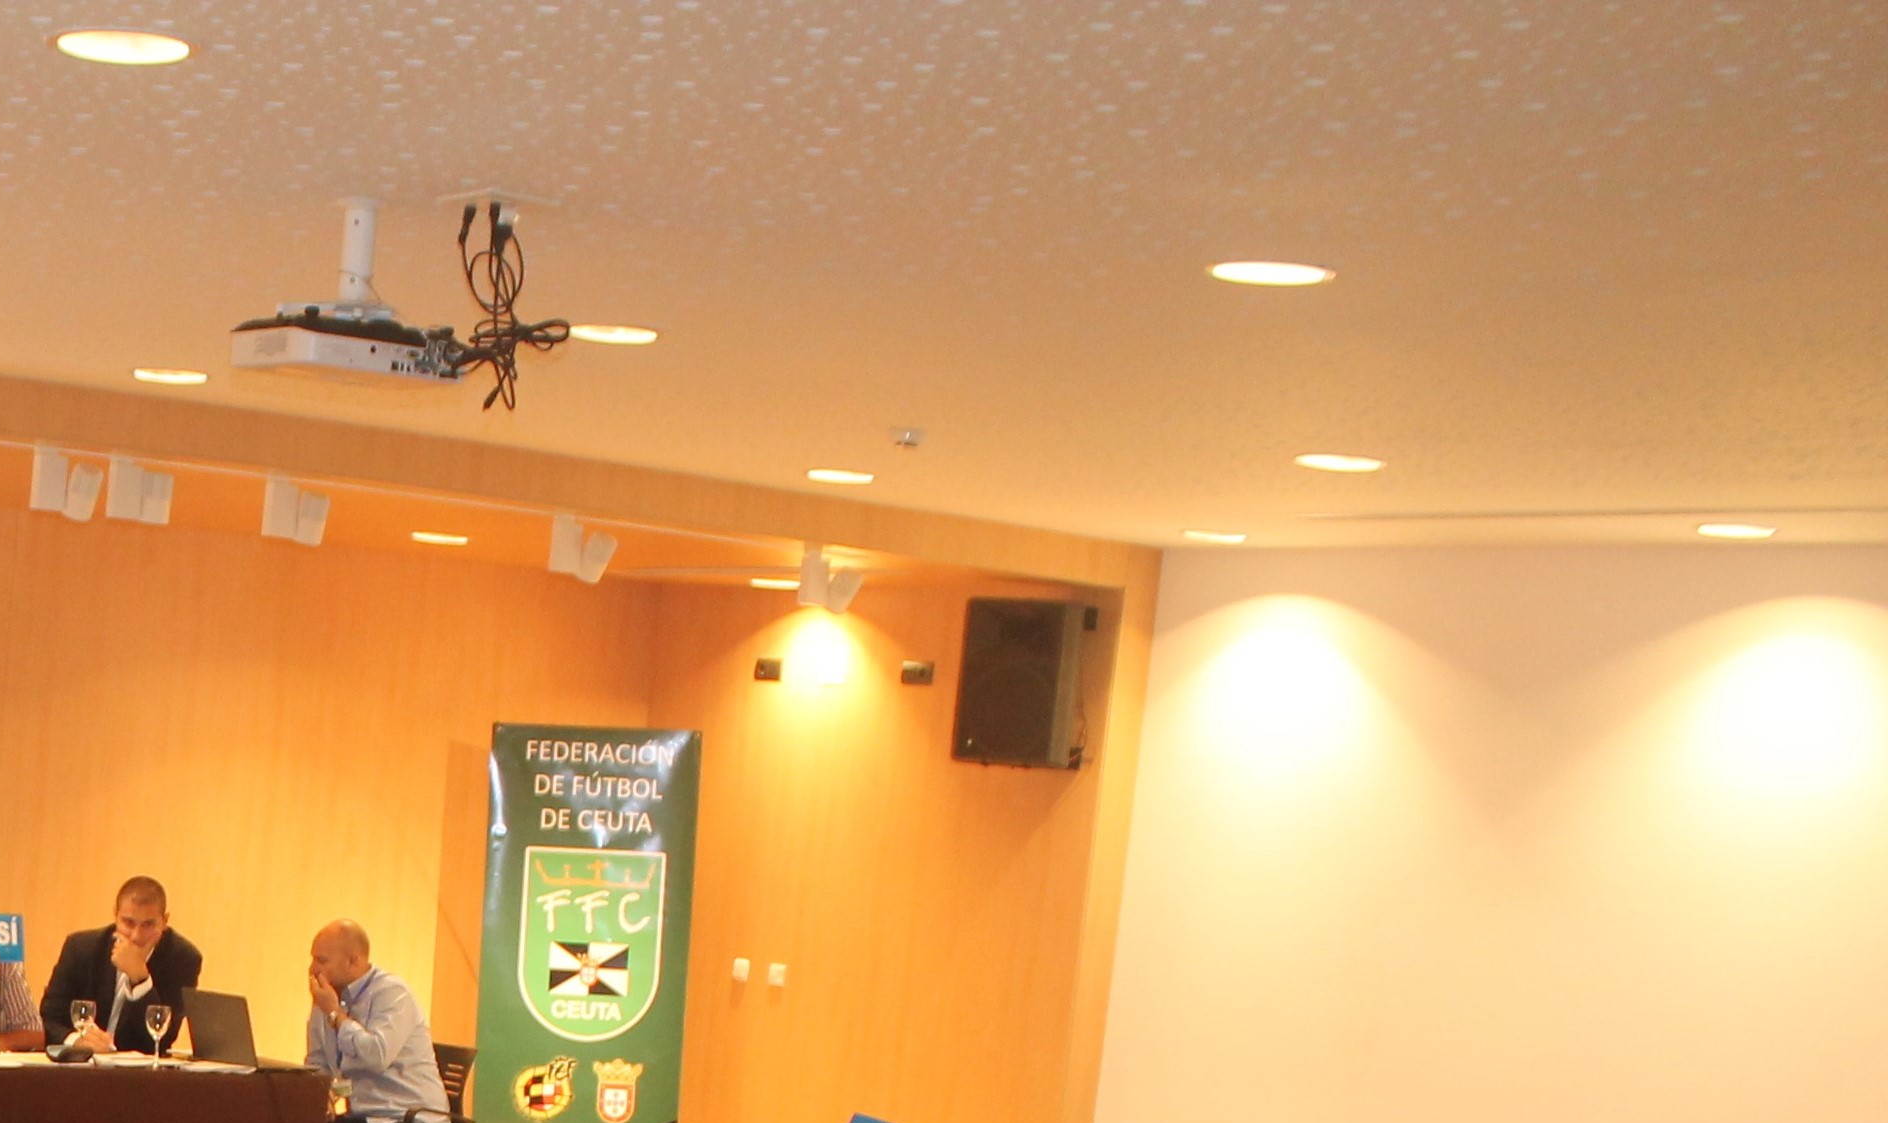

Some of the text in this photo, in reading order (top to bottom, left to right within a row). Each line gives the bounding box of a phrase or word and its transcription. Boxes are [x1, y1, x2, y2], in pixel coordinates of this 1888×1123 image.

[526, 739, 674, 767] FEDERACIÓN
[534, 771, 663, 800] DE FÚTBOL
[540, 808, 653, 833] DE CEUTA
[536, 889, 651, 933] FFC
[550, 999, 622, 1021] CEUTA
